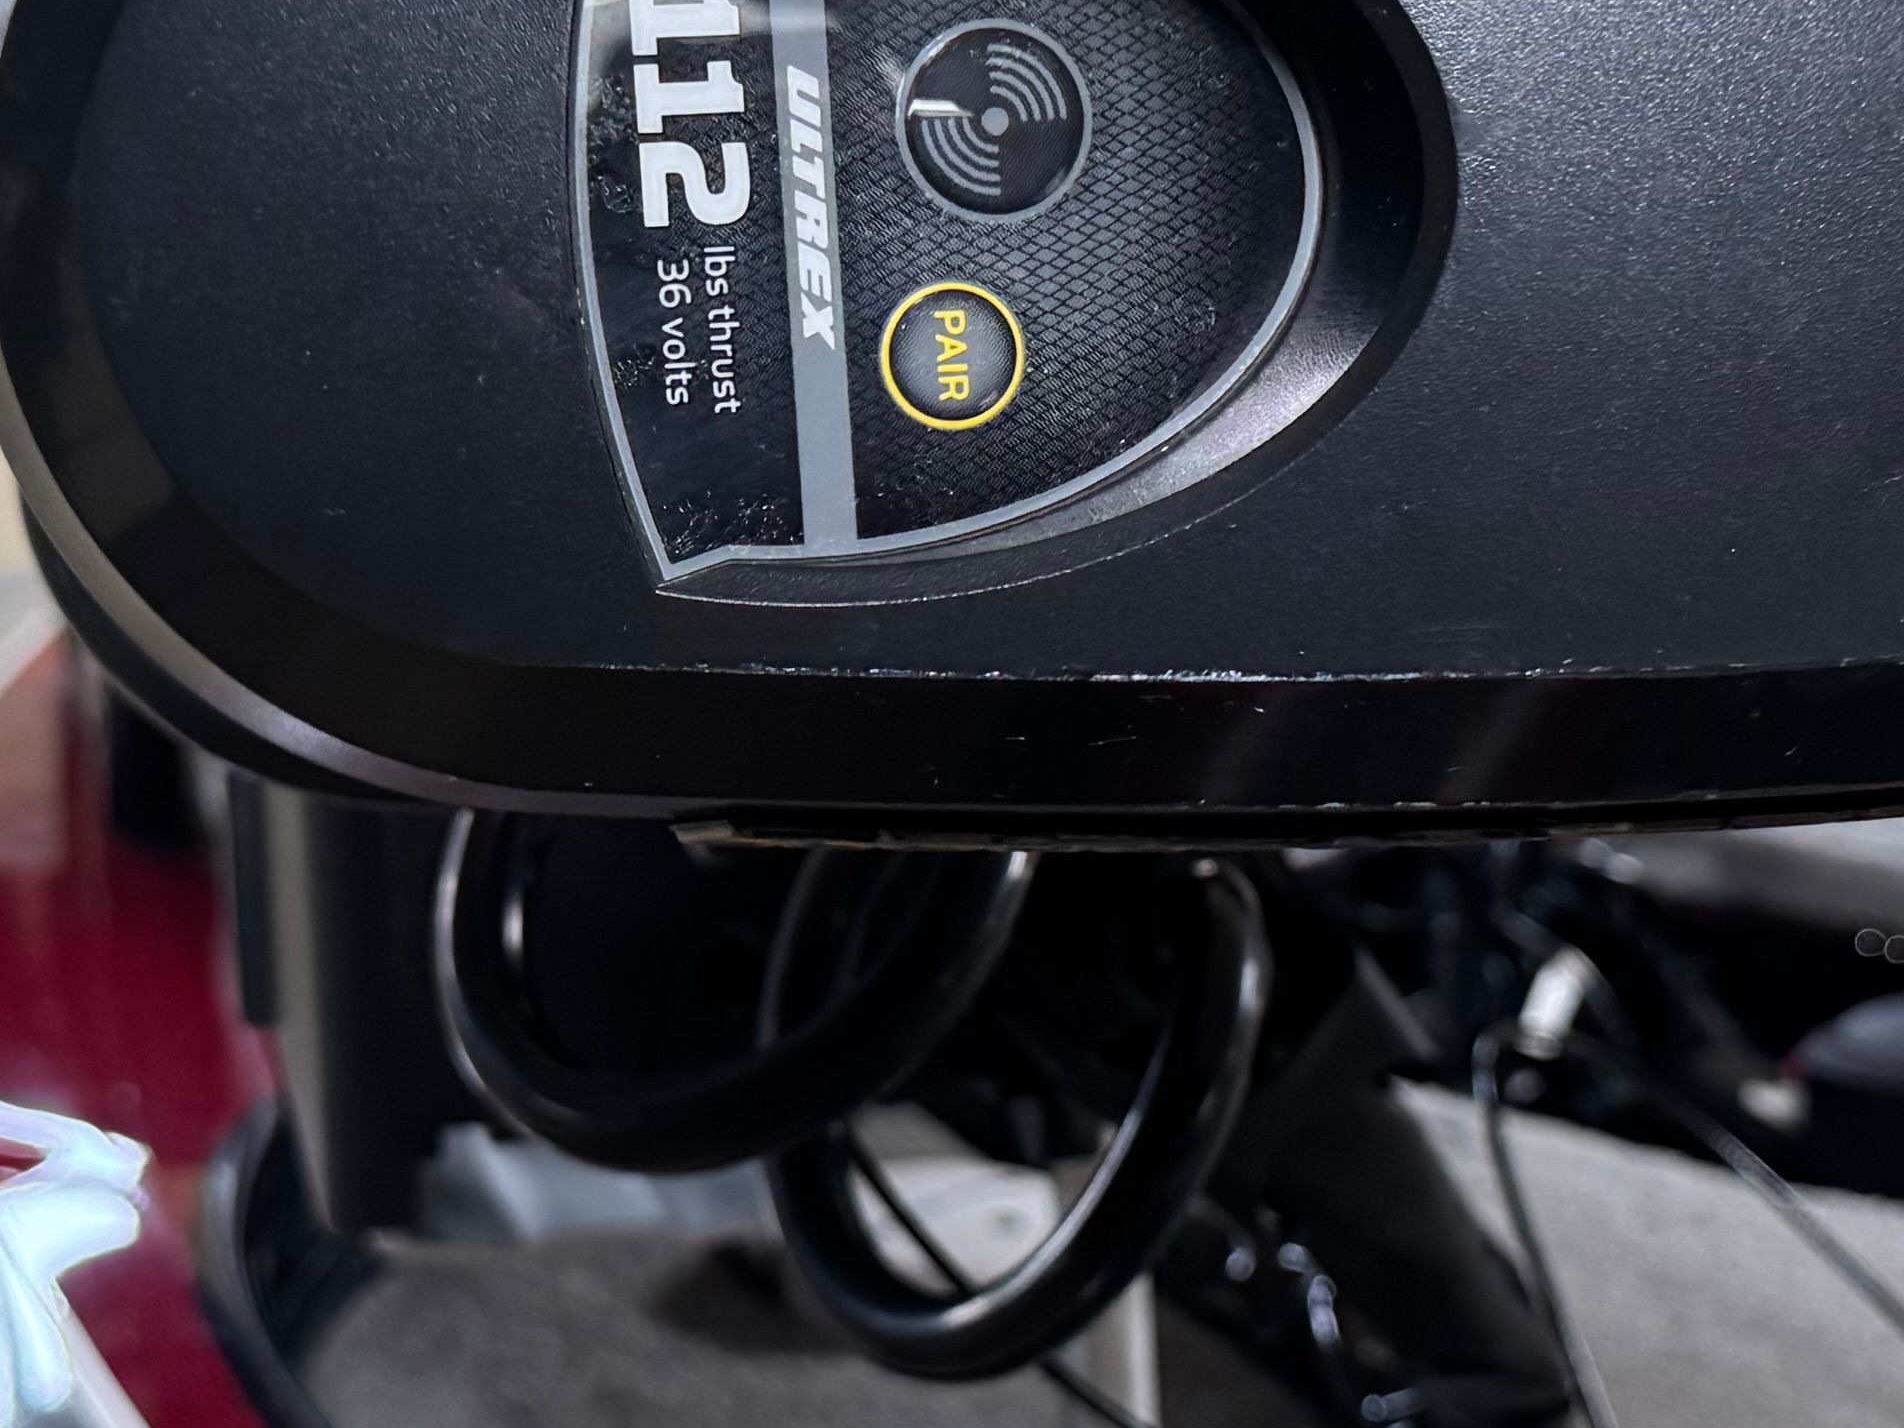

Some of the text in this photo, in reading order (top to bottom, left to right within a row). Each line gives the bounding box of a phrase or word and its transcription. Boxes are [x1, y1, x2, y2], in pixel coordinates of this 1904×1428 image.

[786, 65, 836, 350] ULTREX
[703, 246, 736, 296] lbs
[656, 259, 698, 405] 36 volts
[707, 305, 742, 414] thrust
[933, 309, 970, 401] PAIR
